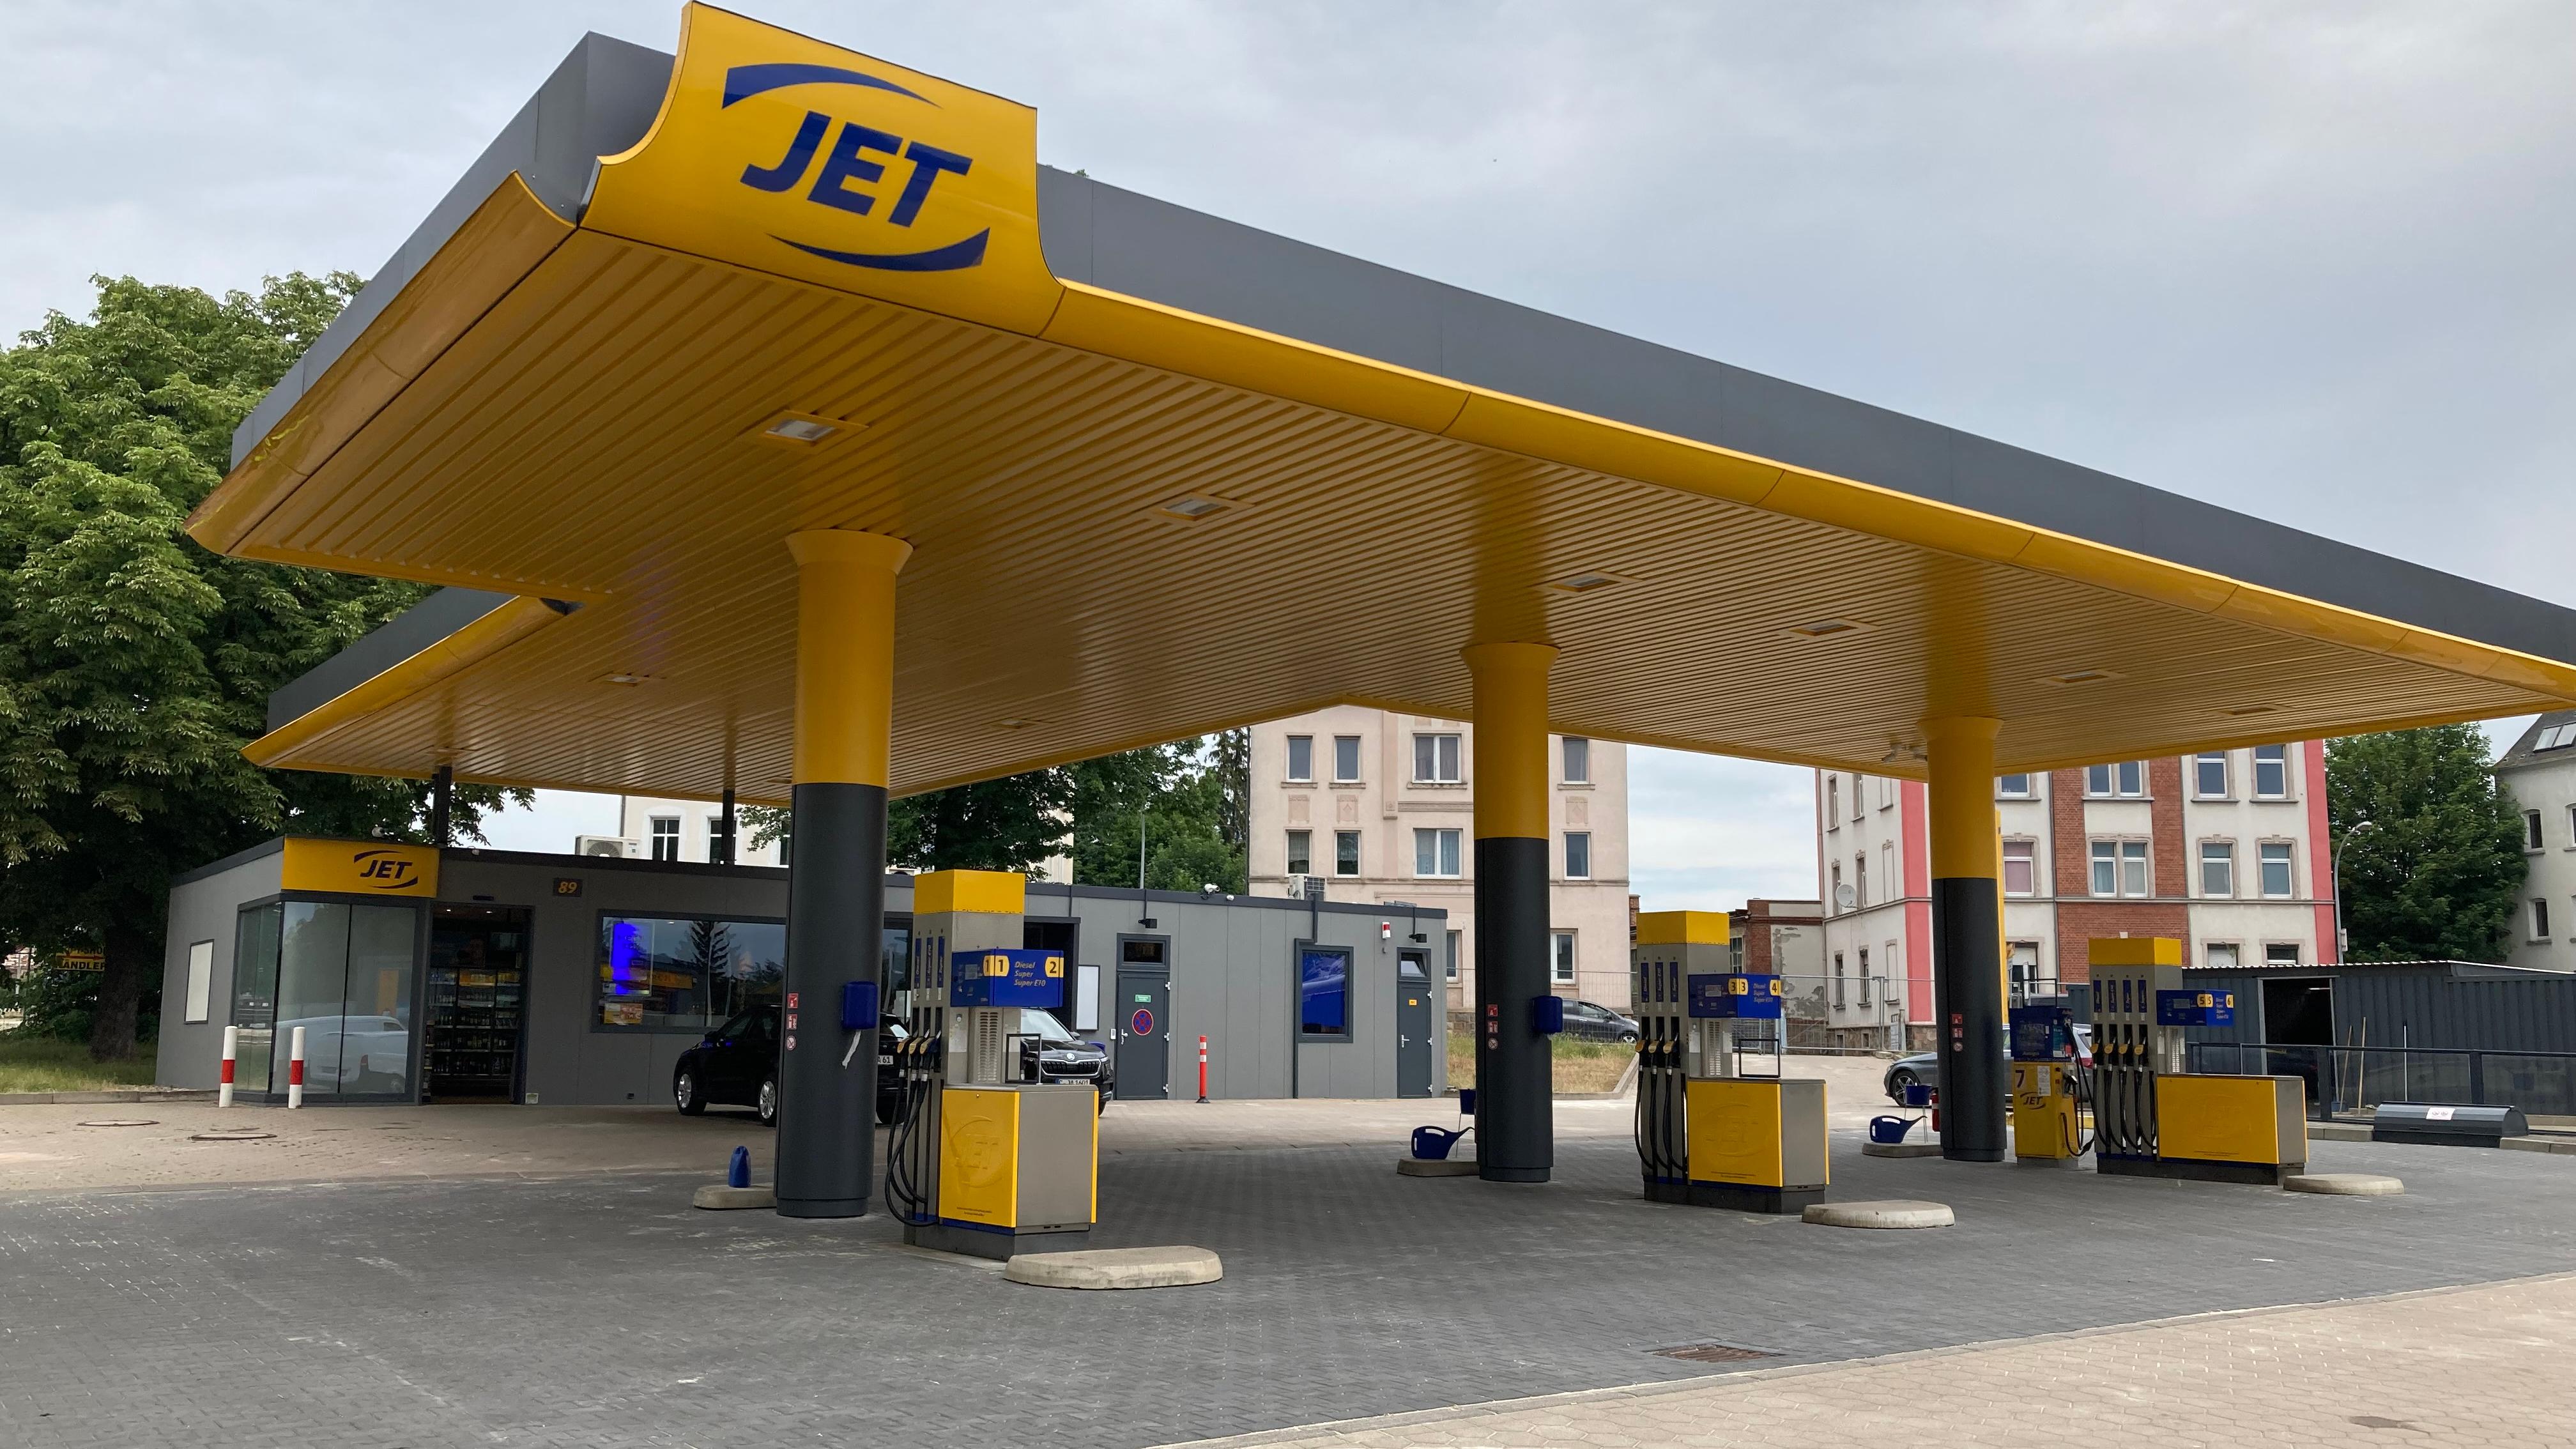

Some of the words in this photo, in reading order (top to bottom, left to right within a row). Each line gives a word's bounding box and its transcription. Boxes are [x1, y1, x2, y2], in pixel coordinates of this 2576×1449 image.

[740, 111, 973, 227] JET
[360, 859, 413, 879] JET
[558, 881, 578, 894] 89
[985, 959, 990, 972] 1
[997, 959, 1004, 972] 1
[1049, 961, 1057, 974] 2
[1014, 970, 1034, 978] Super
[1013, 979, 1034, 988] Super
[1034, 979, 1046, 987] E10
[1731, 981, 1736, 992] 3
[1741, 981, 1746, 992] 3
[1772, 983, 1777, 993] 4
[2200, 996, 2204, 1005] 5
[2227, 997, 2231, 1006] 6
[2015, 1070, 2025, 1088] 7
[2023, 1096, 2043, 1105] JET
